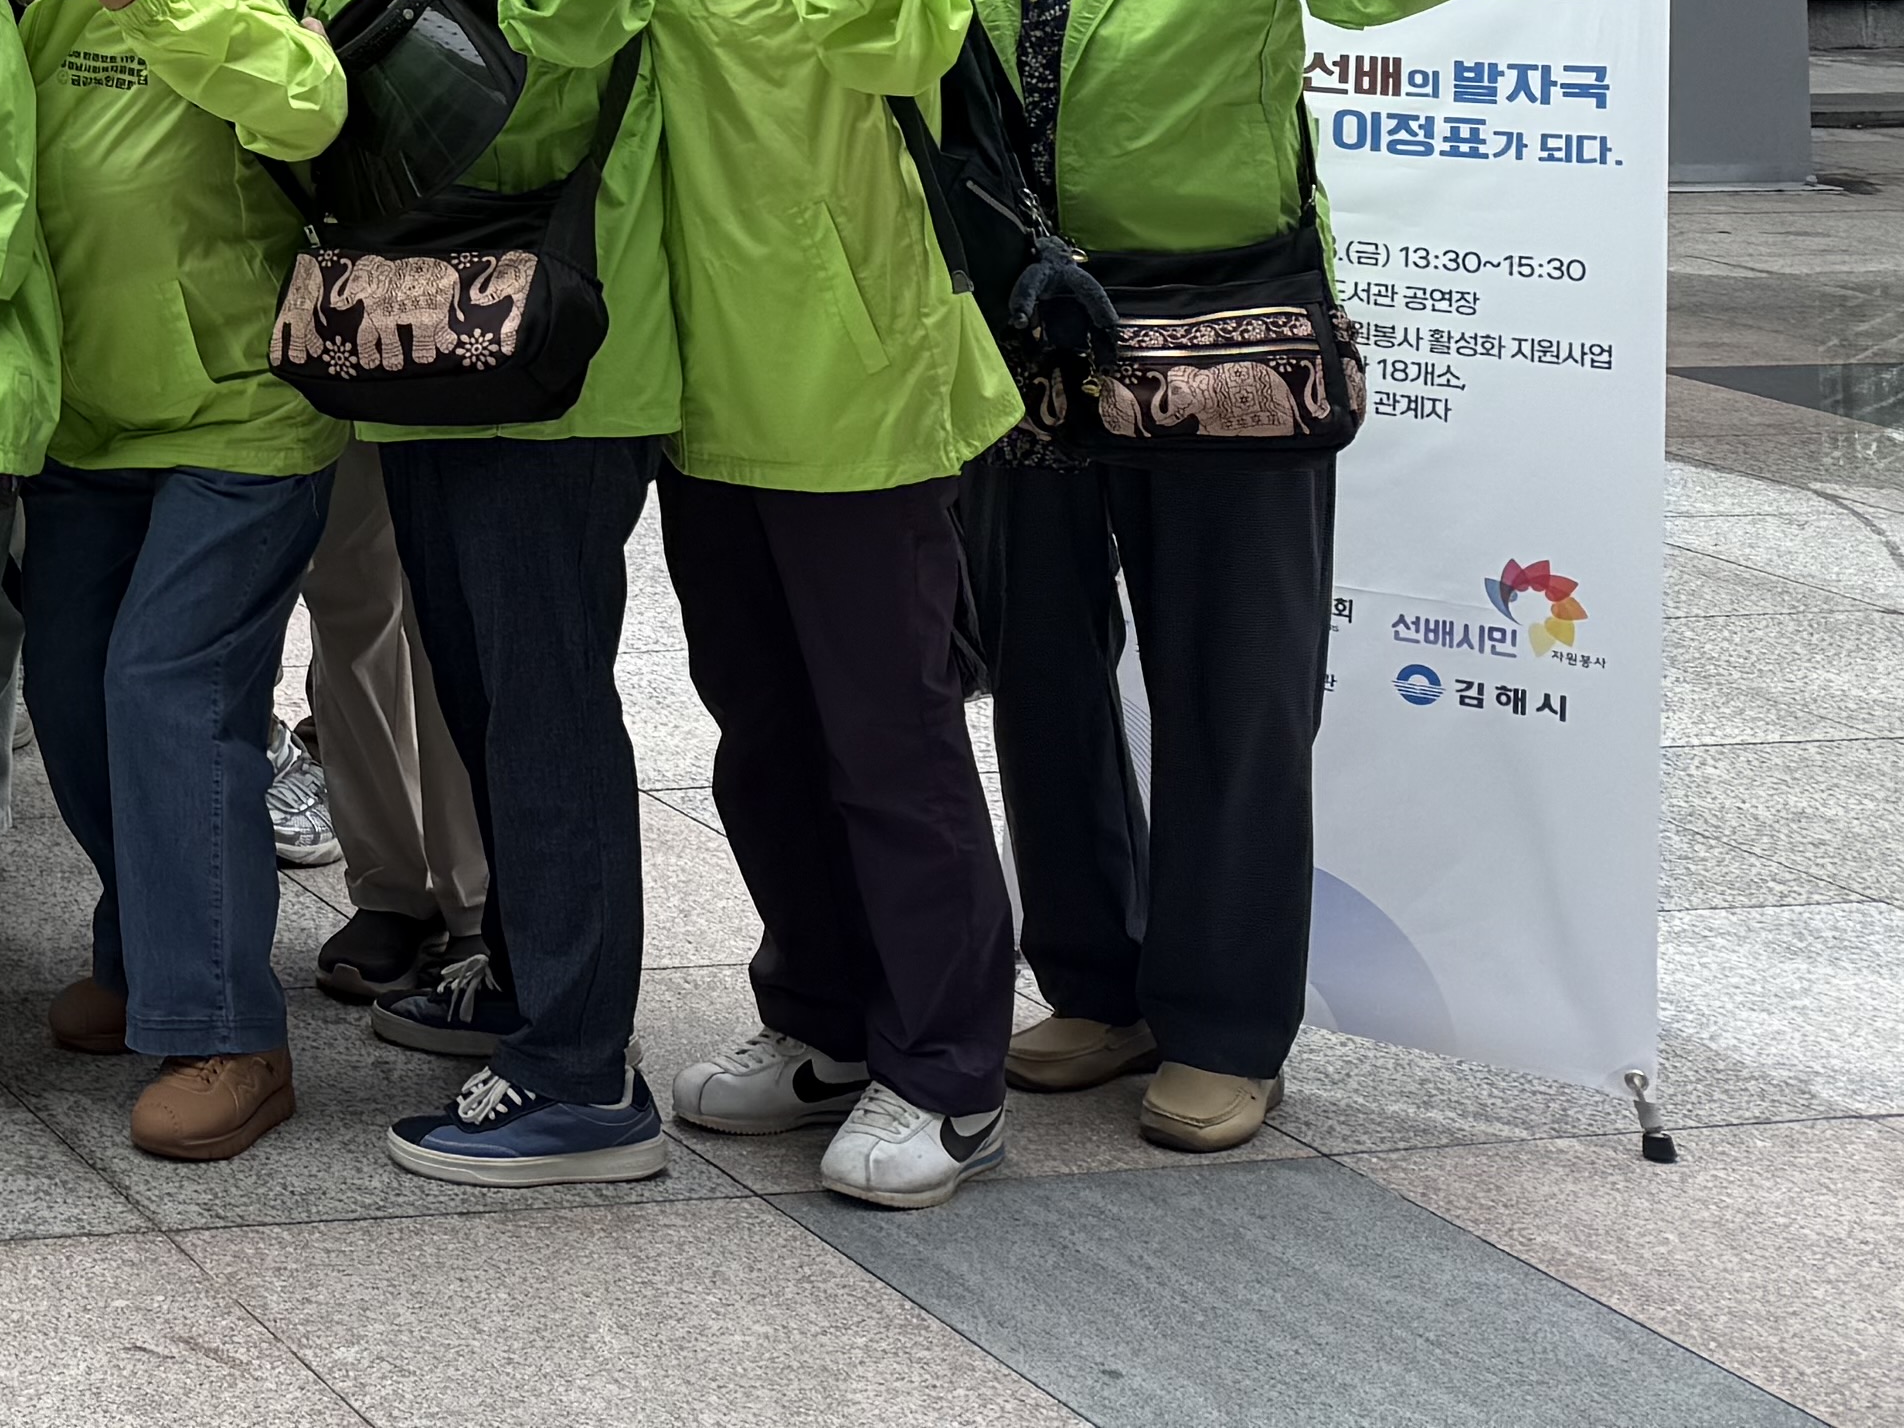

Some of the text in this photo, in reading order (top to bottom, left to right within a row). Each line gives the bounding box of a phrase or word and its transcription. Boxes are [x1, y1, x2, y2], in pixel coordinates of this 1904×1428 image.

[1303, 52, 1611, 110] 선배의 발자국
[1332, 109, 1528, 160] 이정표가
[1538, 132, 1624, 167] 되다.
[1330, 239, 1587, 282] .(금) 13:30~15:30
[1403, 287, 1481, 317] 공연장
[1427, 328, 1506, 360] 활성화
[1510, 336, 1614, 371] 지원사업
[1376, 359, 1467, 392] 18개소,
[1373, 390, 1453, 423] 관계자
[1391, 613, 1518, 658] 선배시민
[1550, 649, 1608, 670] 자원봉사
[1454, 678, 1568, 723] 김해시
